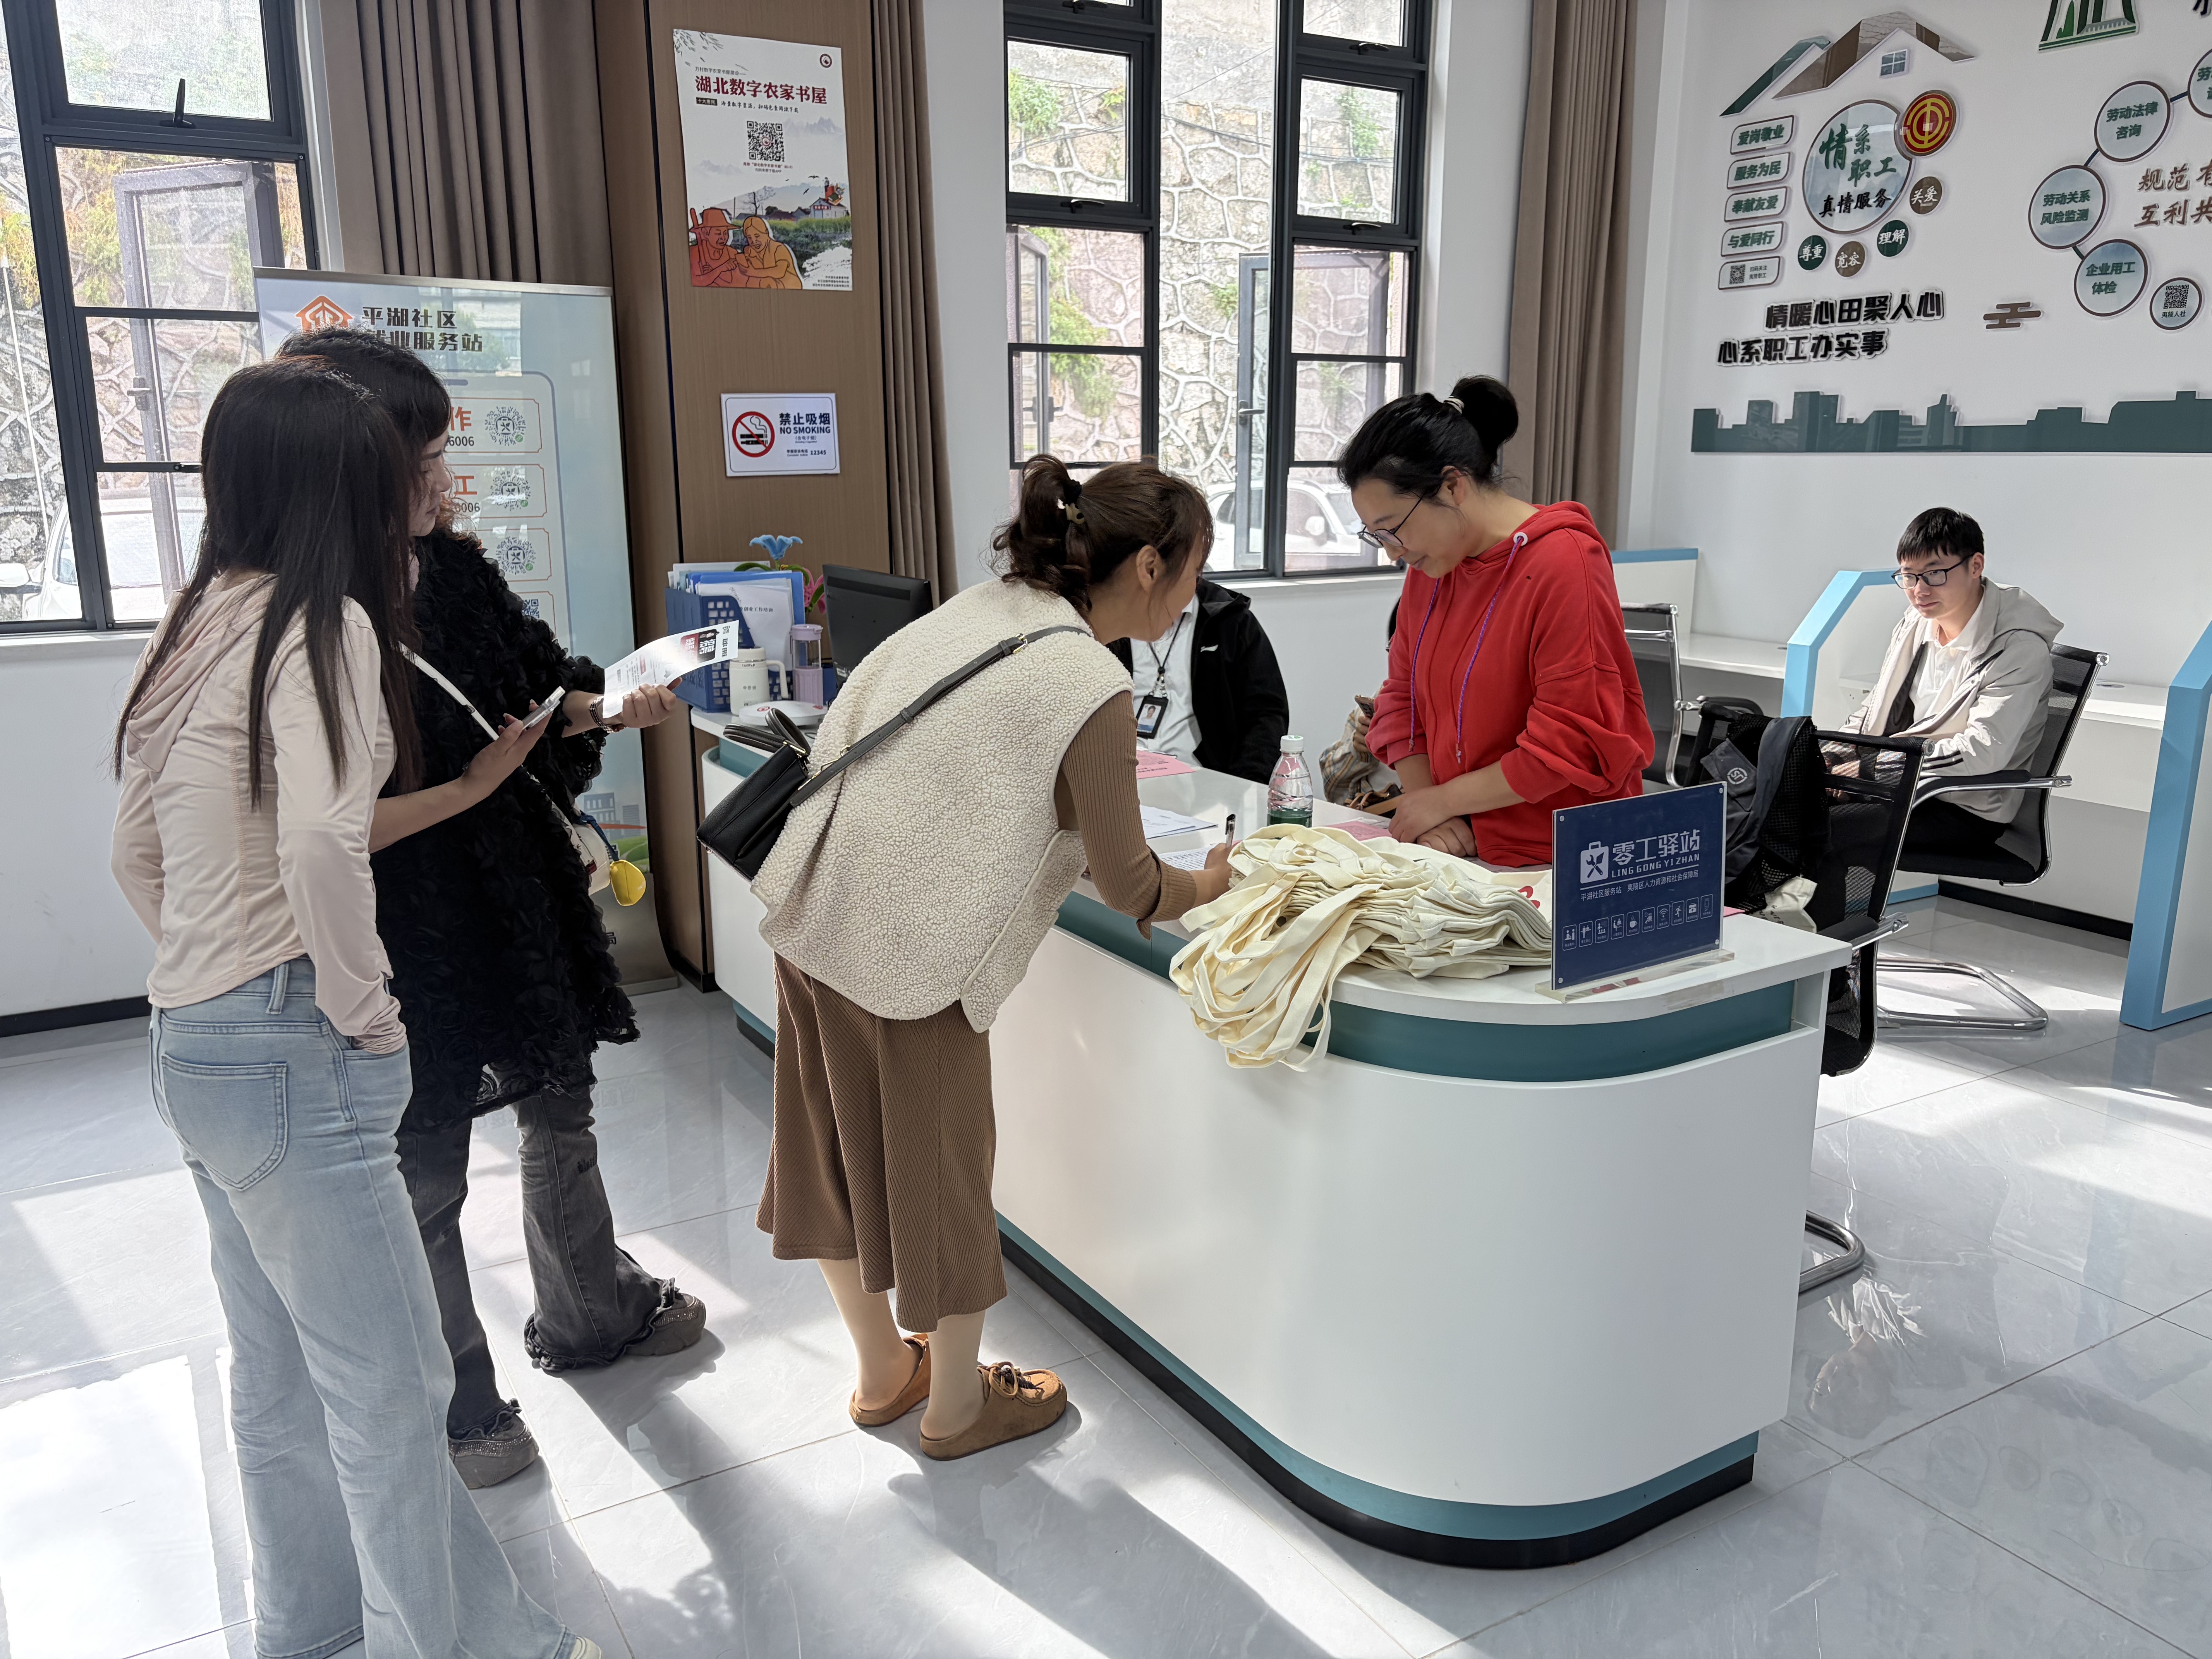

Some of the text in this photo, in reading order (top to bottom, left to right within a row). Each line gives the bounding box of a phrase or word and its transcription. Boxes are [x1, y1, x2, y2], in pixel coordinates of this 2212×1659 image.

[2197, 66, 2212, 81] 劳
[695, 76, 827, 104] 湖北数字农家书屋
[2106, 101, 2159, 122] 劳动法律
[1737, 124, 1785, 146] 爱岗敬业
[2116, 124, 2142, 140] 咨询
[1734, 161, 1781, 180] 服务为民
[1819, 189, 1891, 218] 真情服务
[1911, 186, 1938, 204] 关爱
[2043, 189, 2091, 206] 劳动关系
[1732, 195, 1778, 214] 奉献友爱
[2040, 208, 2090, 225] 风险监测
[1728, 230, 1775, 248] 与爱同行
[1878, 229, 1906, 245] 理解
[1799, 245, 1824, 261] 尊重
[1837, 252, 1861, 268] 宽容
[2086, 261, 2136, 276] 企业用工
[2092, 281, 2117, 295] 体检
[362, 307, 457, 329] 平湖社区
[1765, 292, 1941, 329] 情暖心田聚人心
[1718, 330, 1885, 363] 心系职工办实事
[779, 412, 830, 426] 禁止吸烟
[454, 476, 477, 495] 工
[699, 639, 716, 654] 招聘
[1612, 829, 1700, 866] 零工驿站
[1612, 867, 1634, 878] LING
[1637, 861, 1661, 873] GONG
[1580, 870, 1698, 902] 平湖社区服务站 夷陵区人力资源和社会保障局
